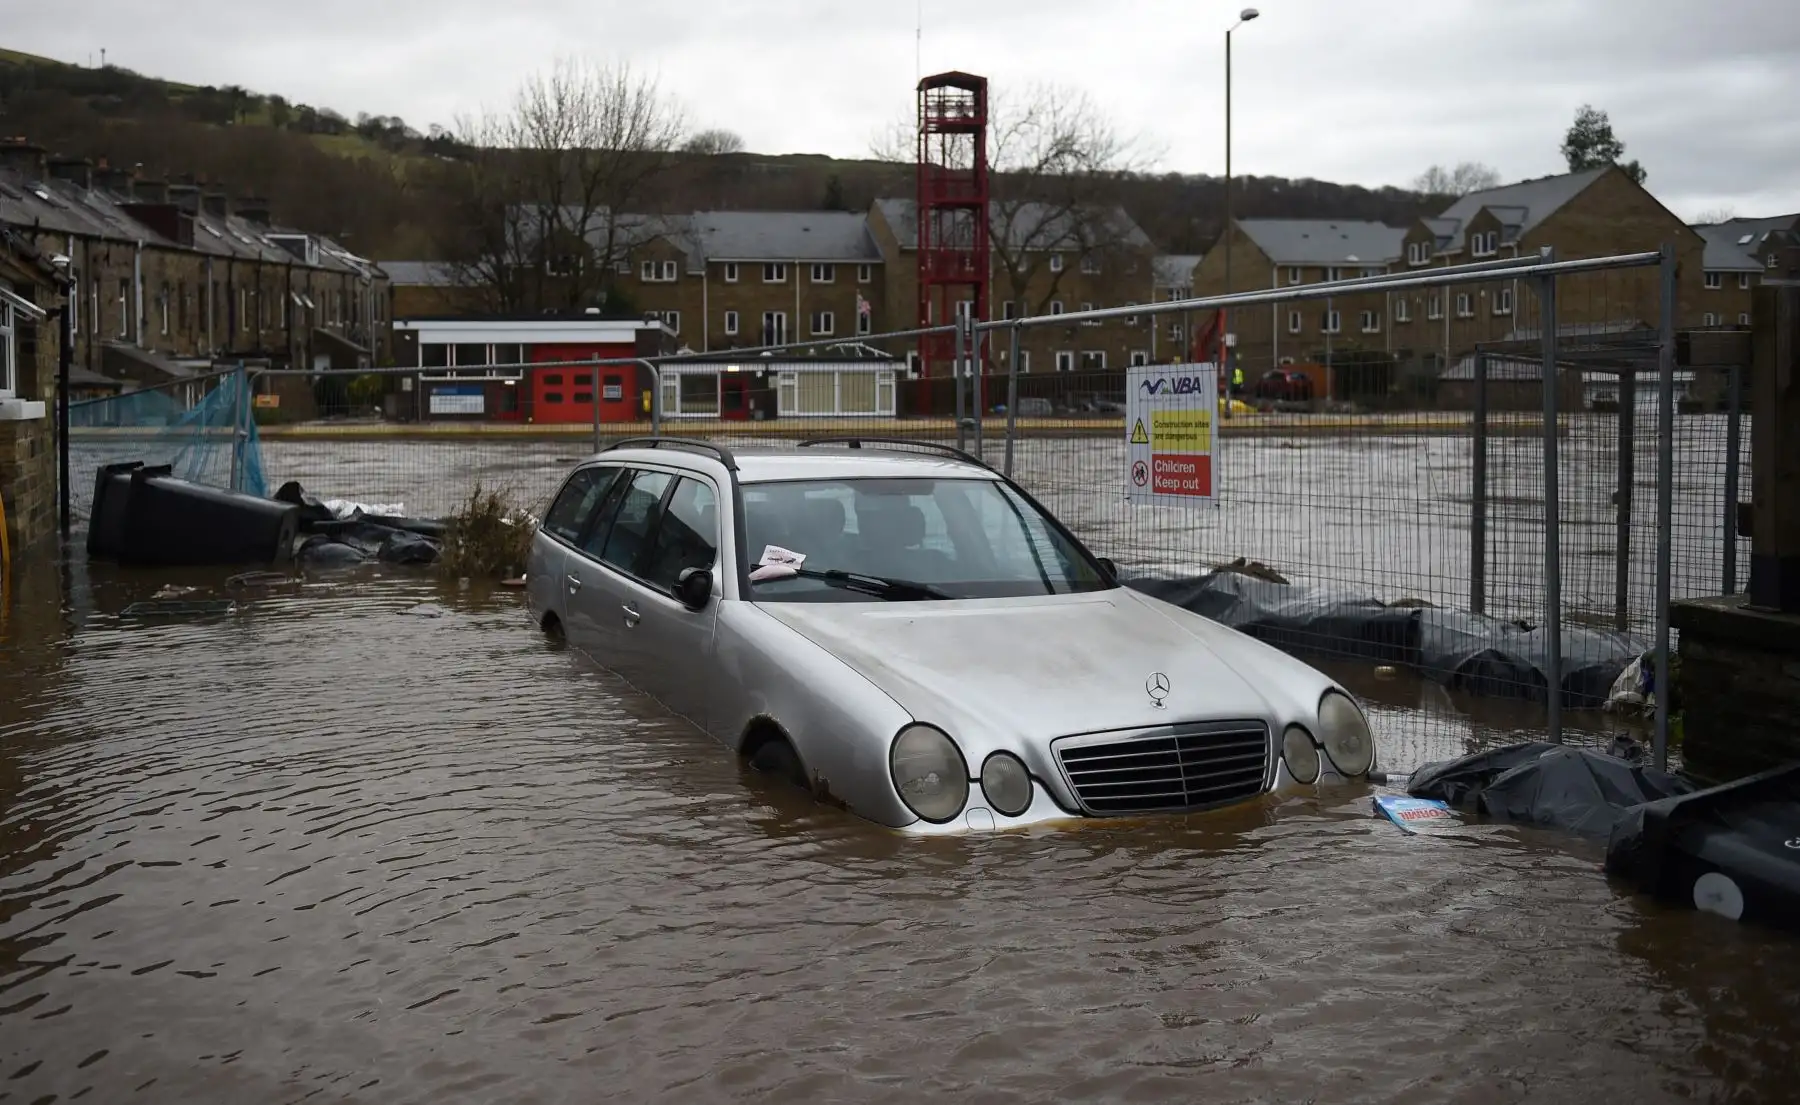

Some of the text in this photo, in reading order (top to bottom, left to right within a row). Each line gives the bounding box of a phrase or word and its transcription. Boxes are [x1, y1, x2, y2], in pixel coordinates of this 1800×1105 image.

[1171, 377, 1201, 394] VBA
[1154, 420, 1192, 428] Construction
[1166, 432, 1198, 441] dangerous
[1154, 460, 1195, 473] Children
[1155, 475, 1200, 490] Keep out
